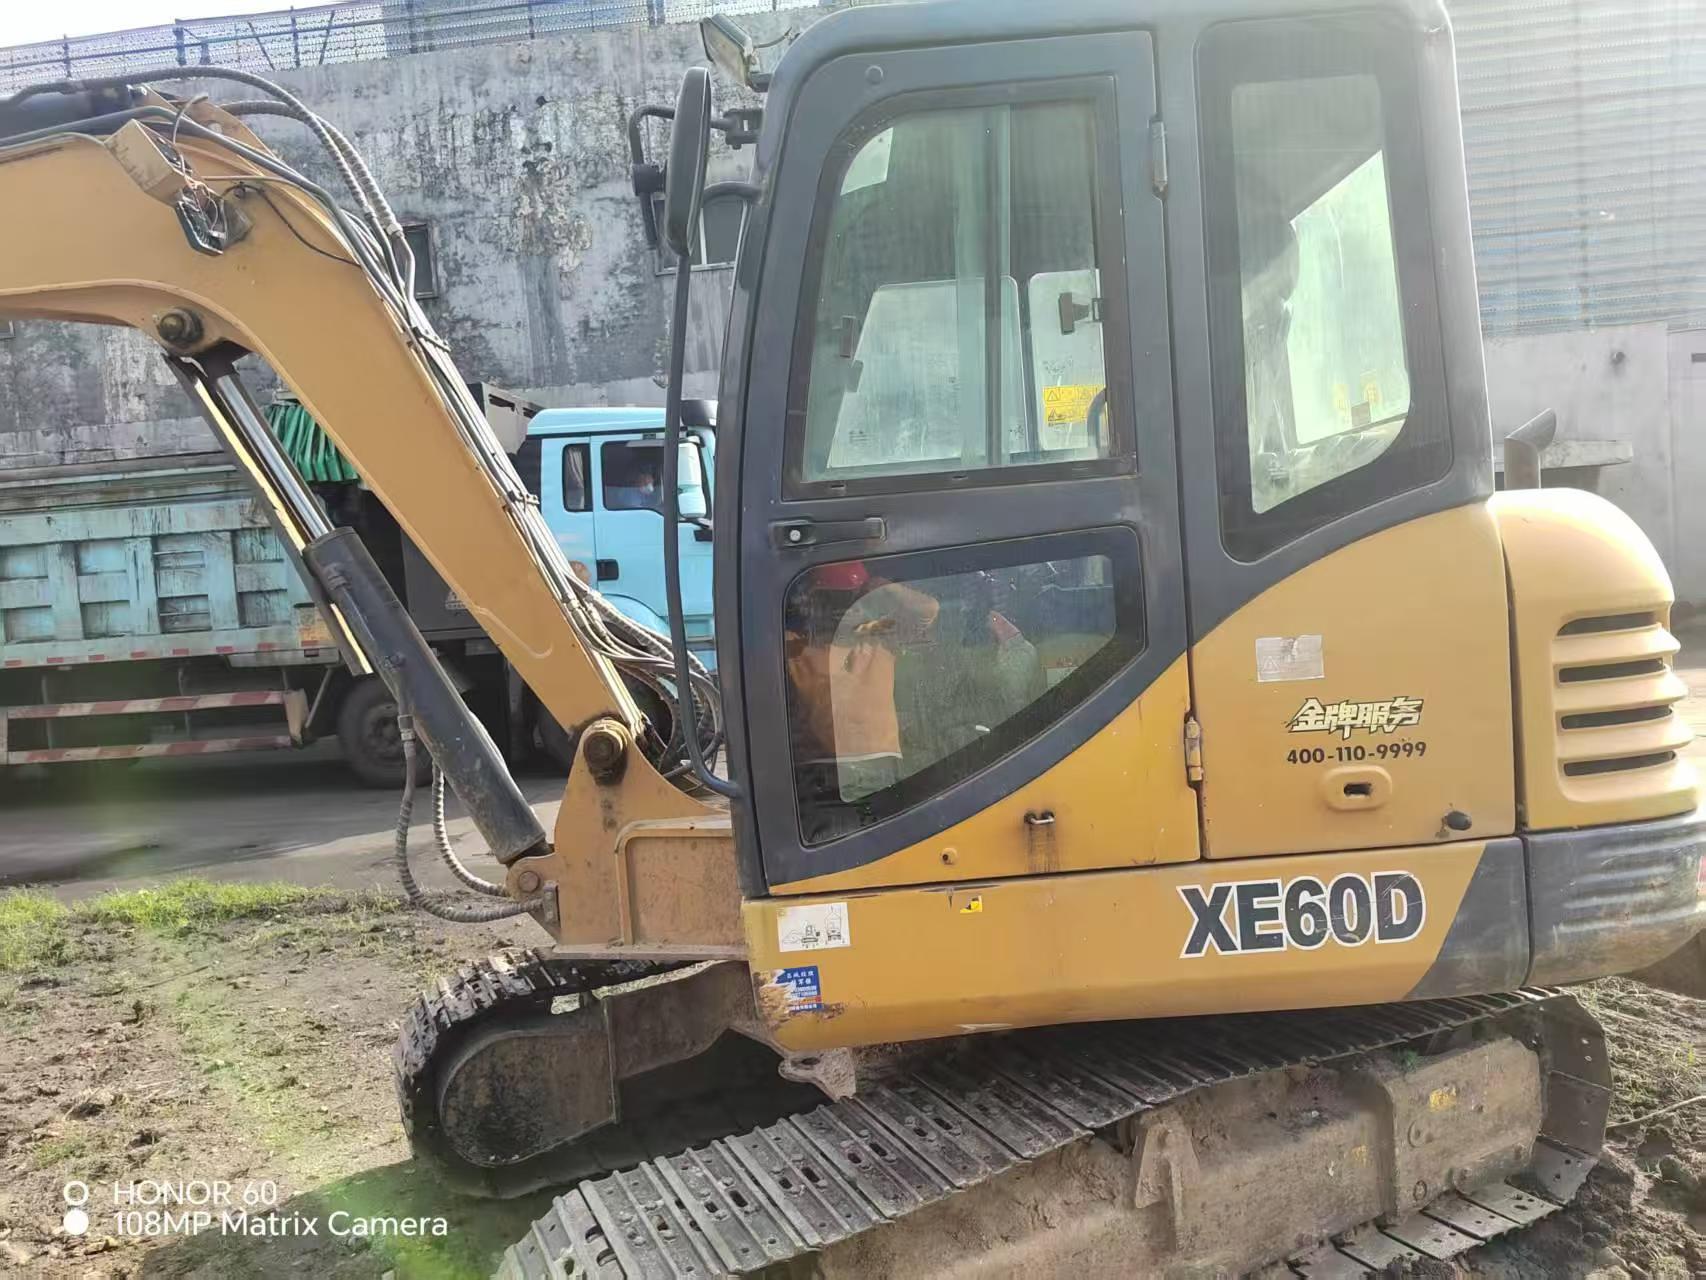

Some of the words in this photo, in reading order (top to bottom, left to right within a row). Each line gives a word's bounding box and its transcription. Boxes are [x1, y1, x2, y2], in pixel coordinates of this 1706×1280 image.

[1286, 696, 1424, 740] 金牌服务
[1287, 741, 1427, 765] 400-110-9999
[1176, 870, 1426, 958] XE60D
